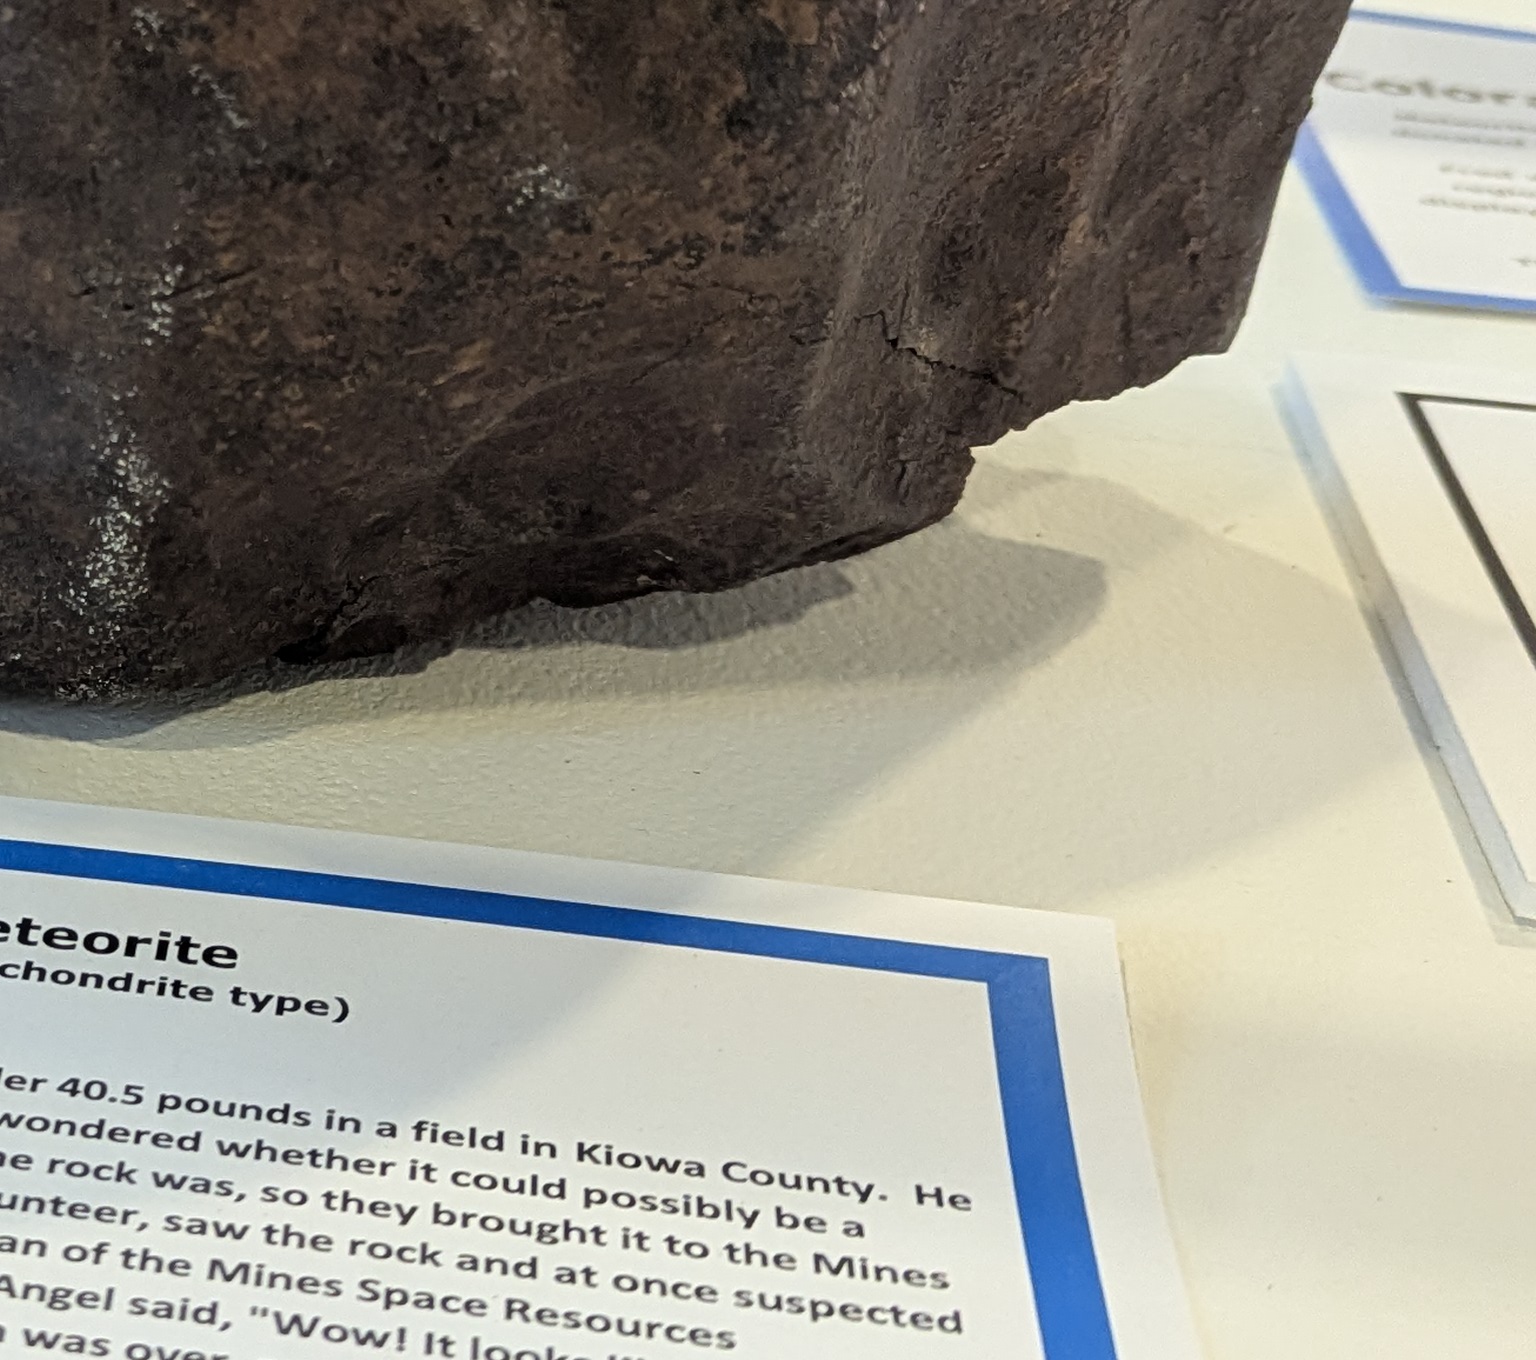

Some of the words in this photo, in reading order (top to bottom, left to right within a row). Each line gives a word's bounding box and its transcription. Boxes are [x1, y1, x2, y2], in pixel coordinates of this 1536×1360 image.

[228, 984, 350, 1024] type)
[55, 1076, 144, 1106] 40.5
[155, 1092, 312, 1128] pounds
[410, 1119, 505, 1153] field
[575, 1140, 706, 1179] Kiowa
[720, 1160, 888, 1205] County.
[214, 1137, 397, 1177] whether
[449, 1169, 567, 1201] could
[582, 1185, 760, 1230] possibly
[45, 1157, 138, 1185] rock
[150, 1170, 247, 1203] was,
[320, 1188, 419, 1227] they
[431, 1200, 607, 1248] brought
[811, 1251, 950, 1290] Mines
[127, 1296, 232, 1332] said,
[249, 1304, 407, 1352] "Wow!
[205, 1257, 343, 1298] Mines
[355, 1277, 489, 1318] Space
[504, 1296, 736, 1350] Resources
[347, 1238, 442, 1268] rock
[611, 1273, 719, 1304] once
[733, 1289, 963, 1335] suspected
